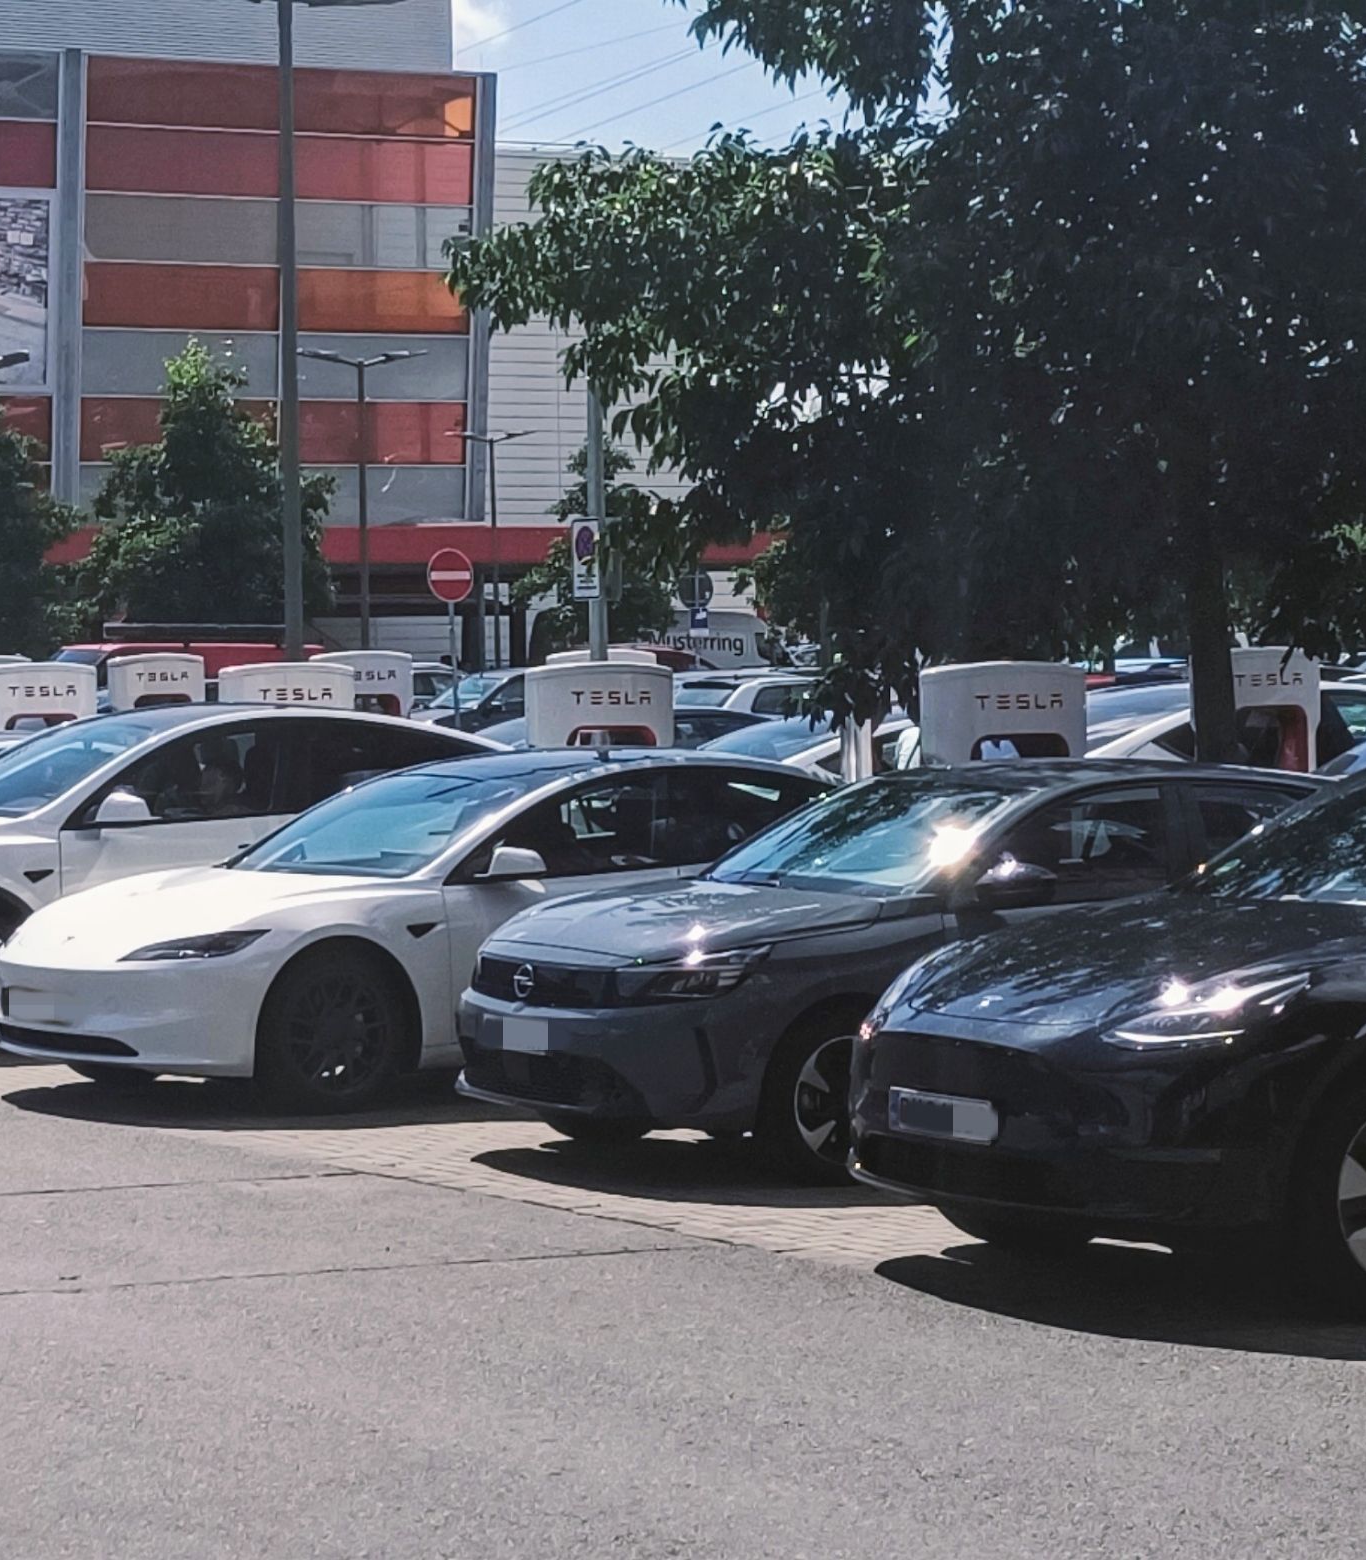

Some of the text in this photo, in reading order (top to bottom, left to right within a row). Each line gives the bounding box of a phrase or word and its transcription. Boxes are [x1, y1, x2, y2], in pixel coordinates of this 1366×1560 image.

[136, 672, 189, 682] TESLA
[354, 670, 397, 681] ESLA
[1235, 672, 1303, 687] TESLA
[8, 684, 77, 697] TESLA
[259, 688, 333, 701] TESLA
[571, 691, 652, 705] TESLA
[974, 693, 1064, 710] TESLA
